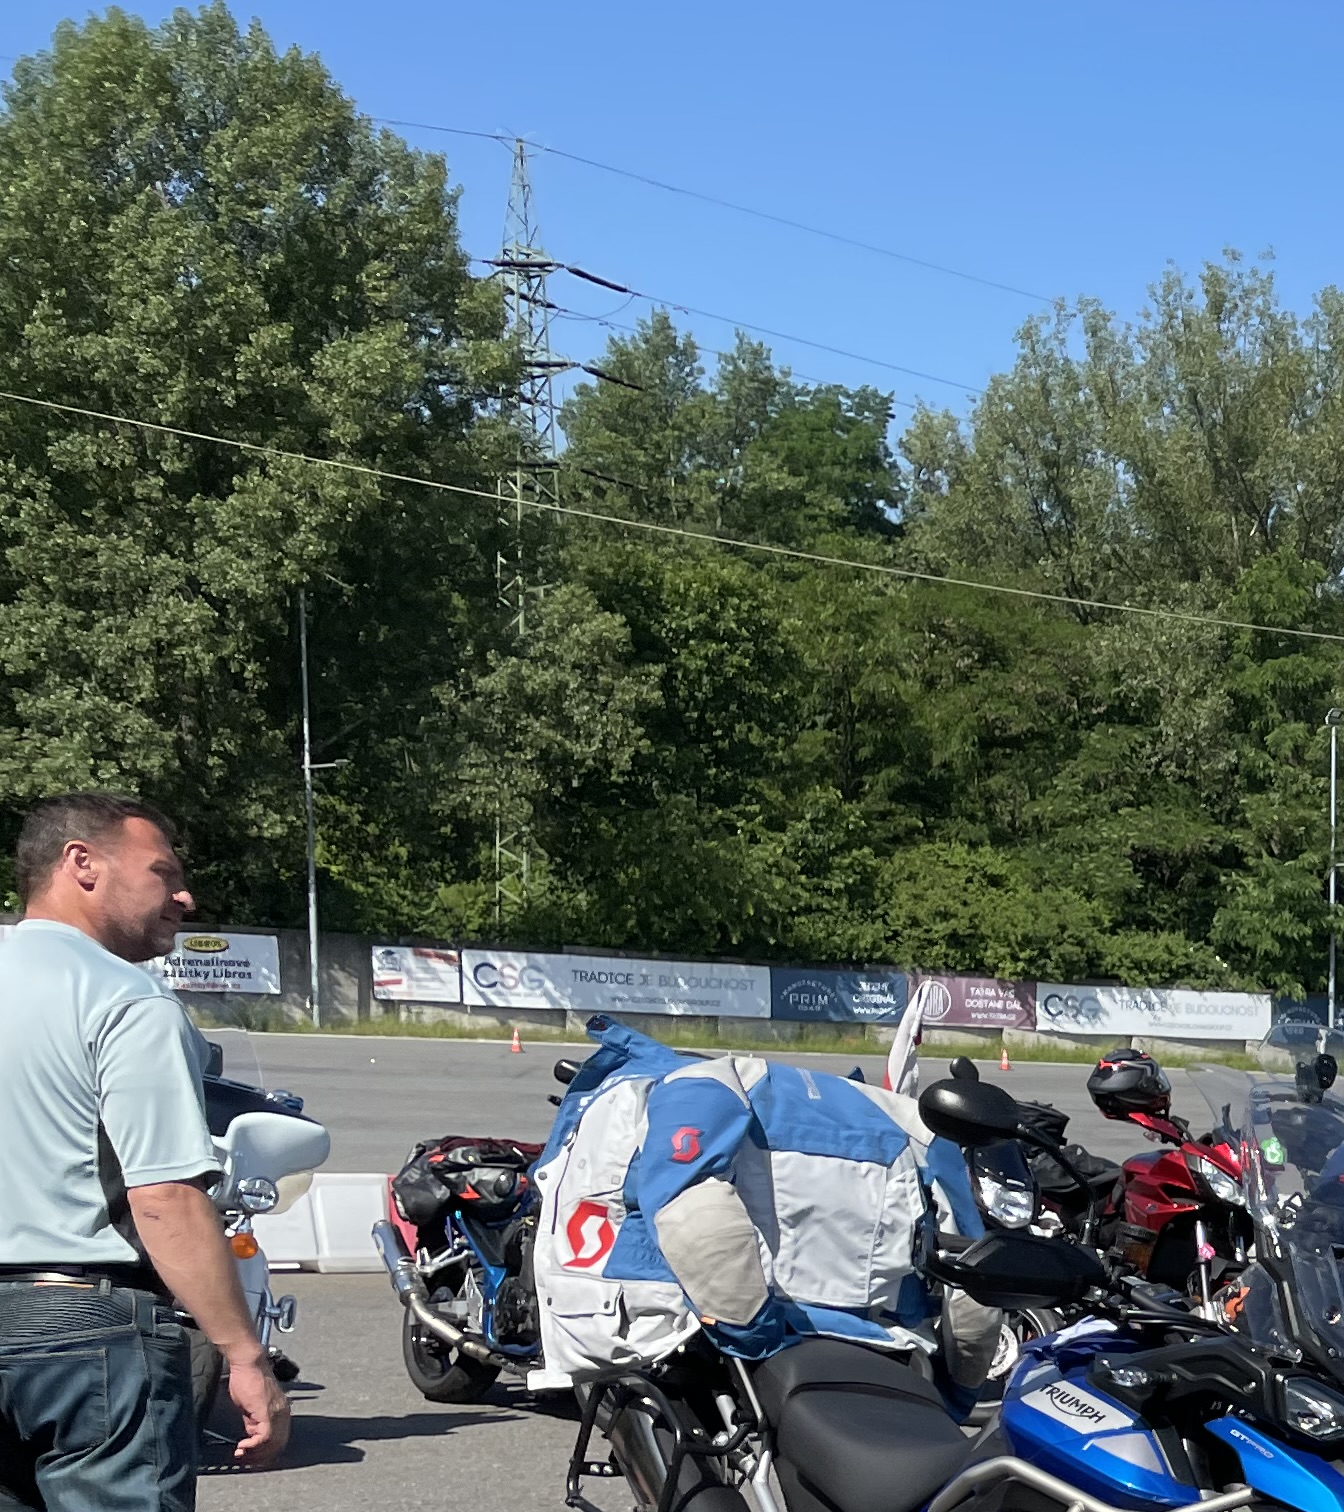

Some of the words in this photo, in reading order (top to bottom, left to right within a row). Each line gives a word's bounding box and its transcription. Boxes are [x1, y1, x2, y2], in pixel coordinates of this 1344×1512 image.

[473, 962, 546, 991] CSG
[572, 969, 635, 986] TRADICE
[658, 975, 757, 992] BUDOUCNOST
[789, 993, 829, 1006] PRIM
[1185, 1004, 1260, 1017] BUDOUCNOST
[1039, 1383, 1106, 1425] TRIUMPH
